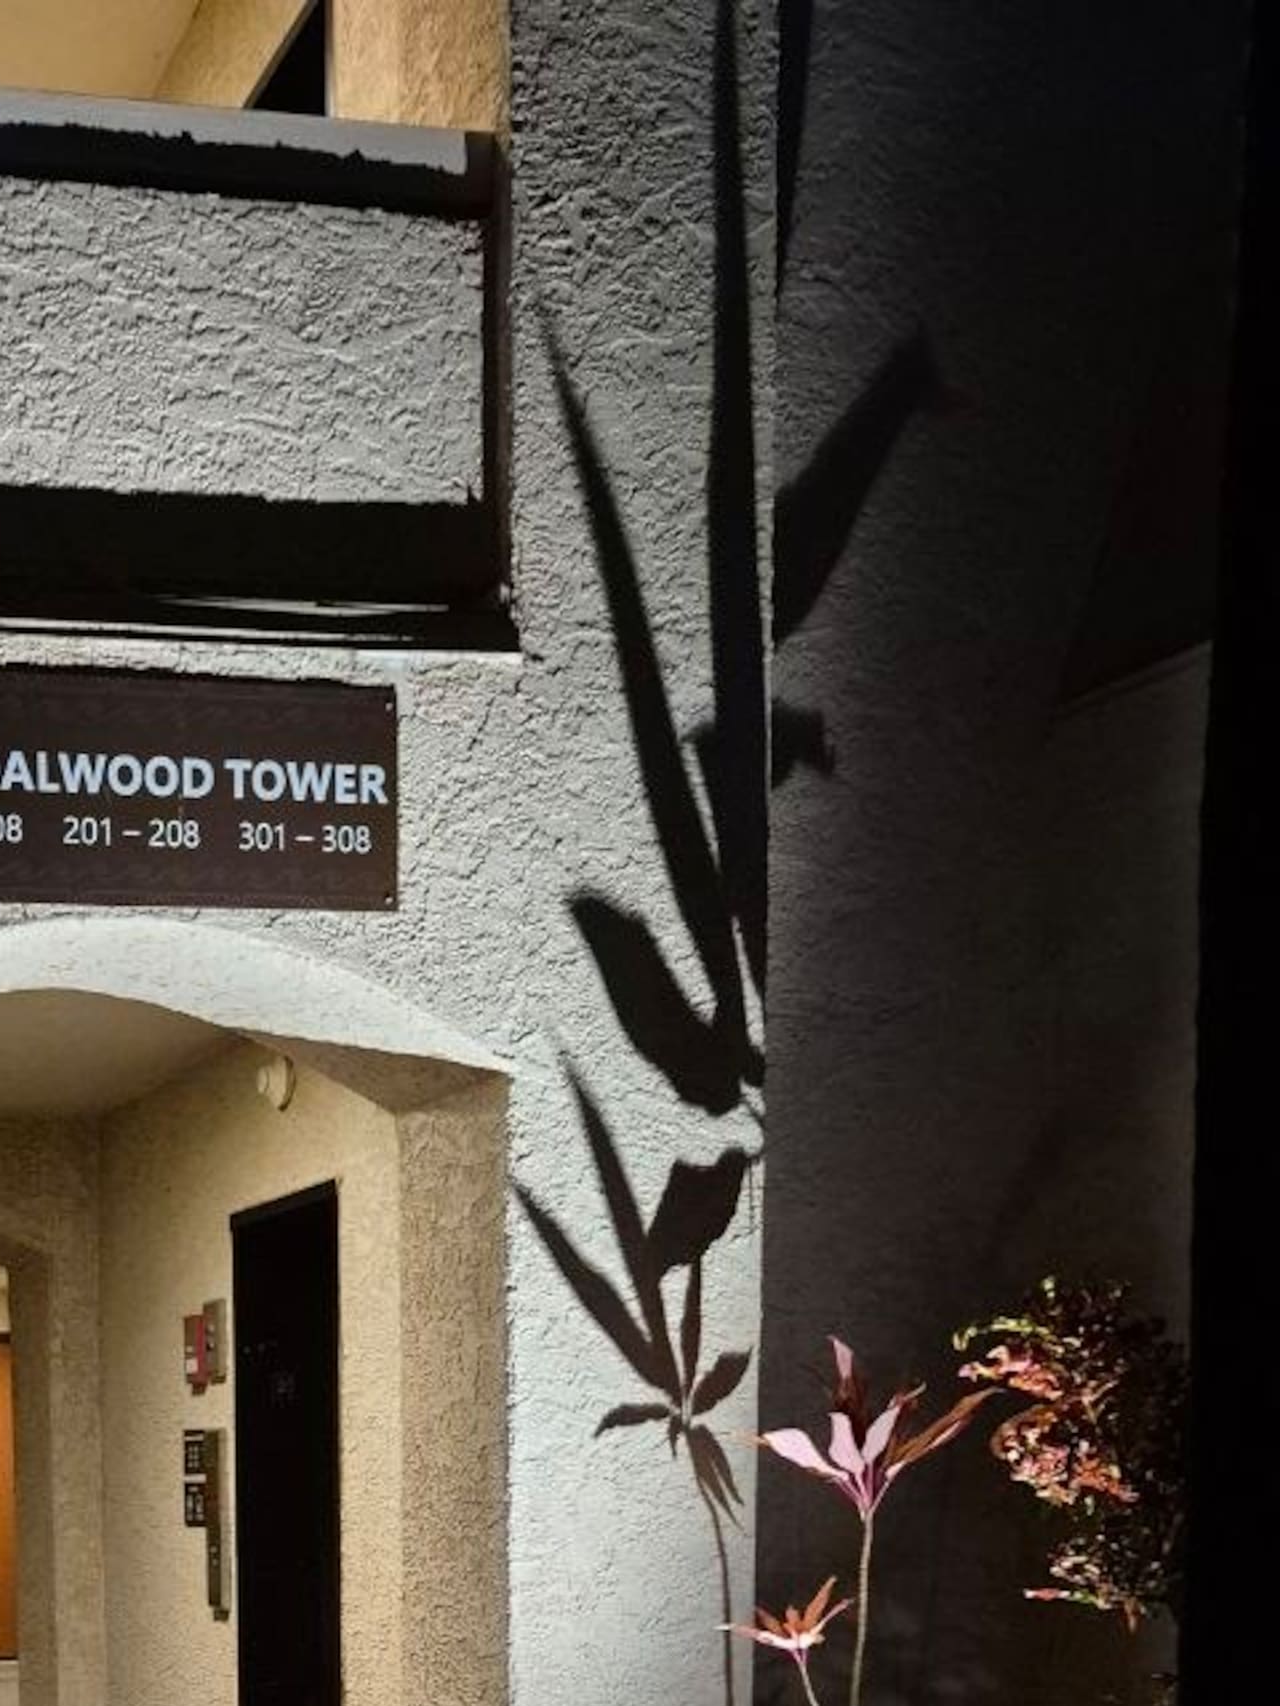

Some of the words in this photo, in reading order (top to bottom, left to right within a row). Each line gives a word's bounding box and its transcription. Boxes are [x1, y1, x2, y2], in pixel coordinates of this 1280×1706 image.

[223, 758, 389, 805] TOWER
[62, 815, 111, 846] 201
[148, 818, 201, 850] 208
[238, 820, 285, 852] 301
[321, 824, 372, 855] 308
